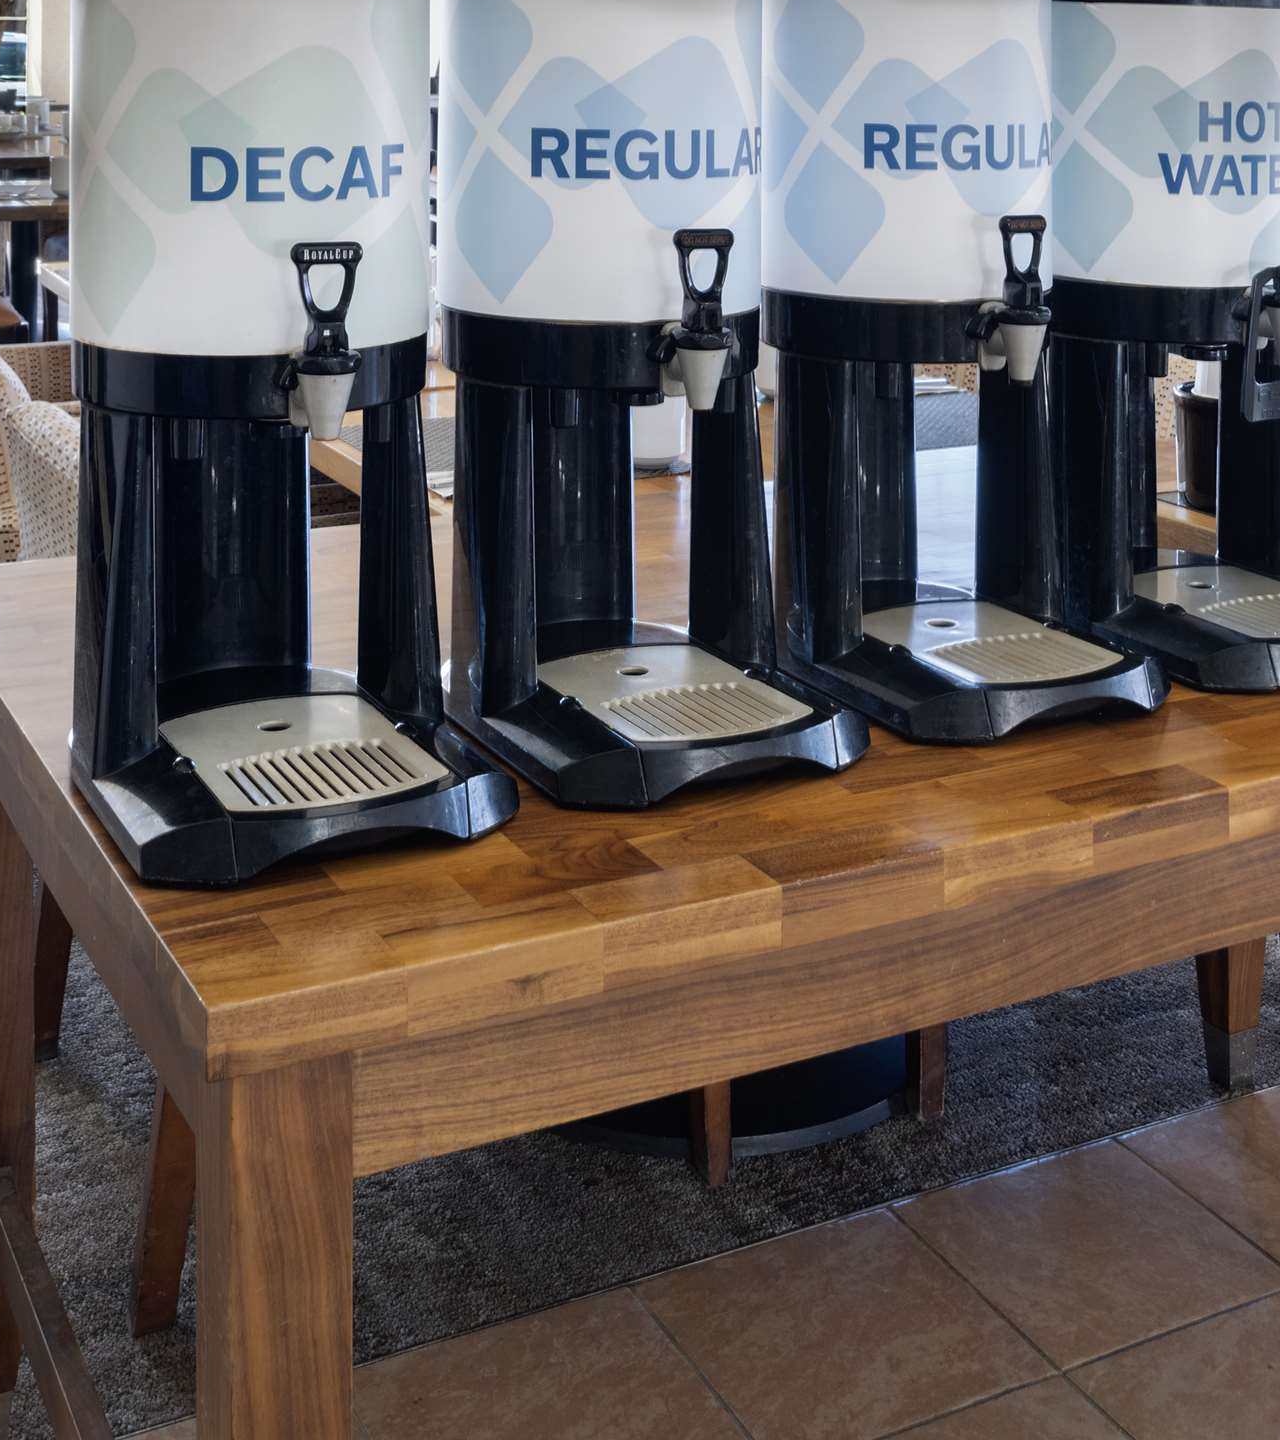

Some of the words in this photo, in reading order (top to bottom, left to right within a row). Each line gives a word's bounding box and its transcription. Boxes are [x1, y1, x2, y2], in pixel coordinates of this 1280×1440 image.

[190, 143, 405, 202] DECAF
[530, 126, 762, 181] REGULAR
[863, 122, 1052, 171] REGULA
